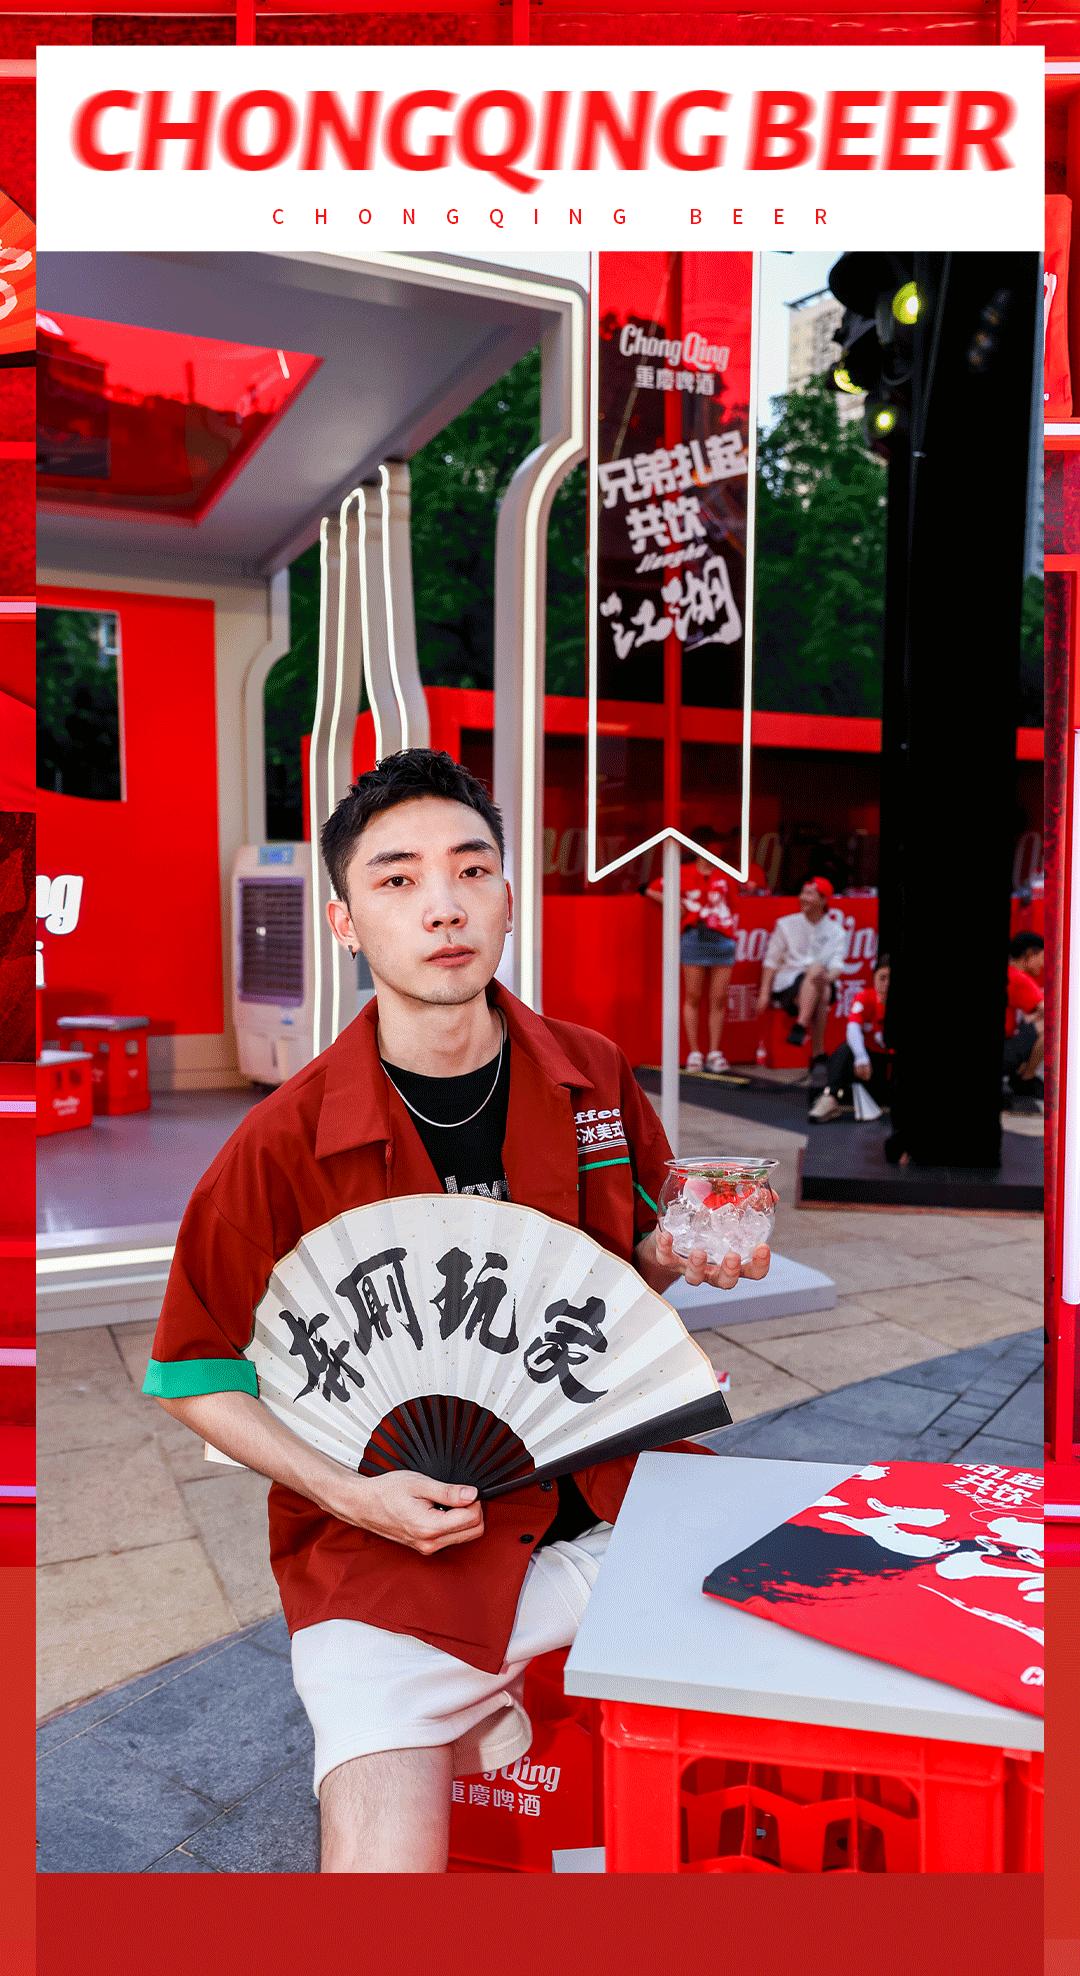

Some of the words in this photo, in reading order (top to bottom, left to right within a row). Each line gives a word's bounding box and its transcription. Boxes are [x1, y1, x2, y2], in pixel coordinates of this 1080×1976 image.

[619, 323, 730, 372] ChongQing
[598, 430, 749, 508] 兄弟扎起
[625, 496, 707, 554] 共饮
[600, 555, 742, 660] 江湖
[576, 1120, 625, 1144] 冰美式
